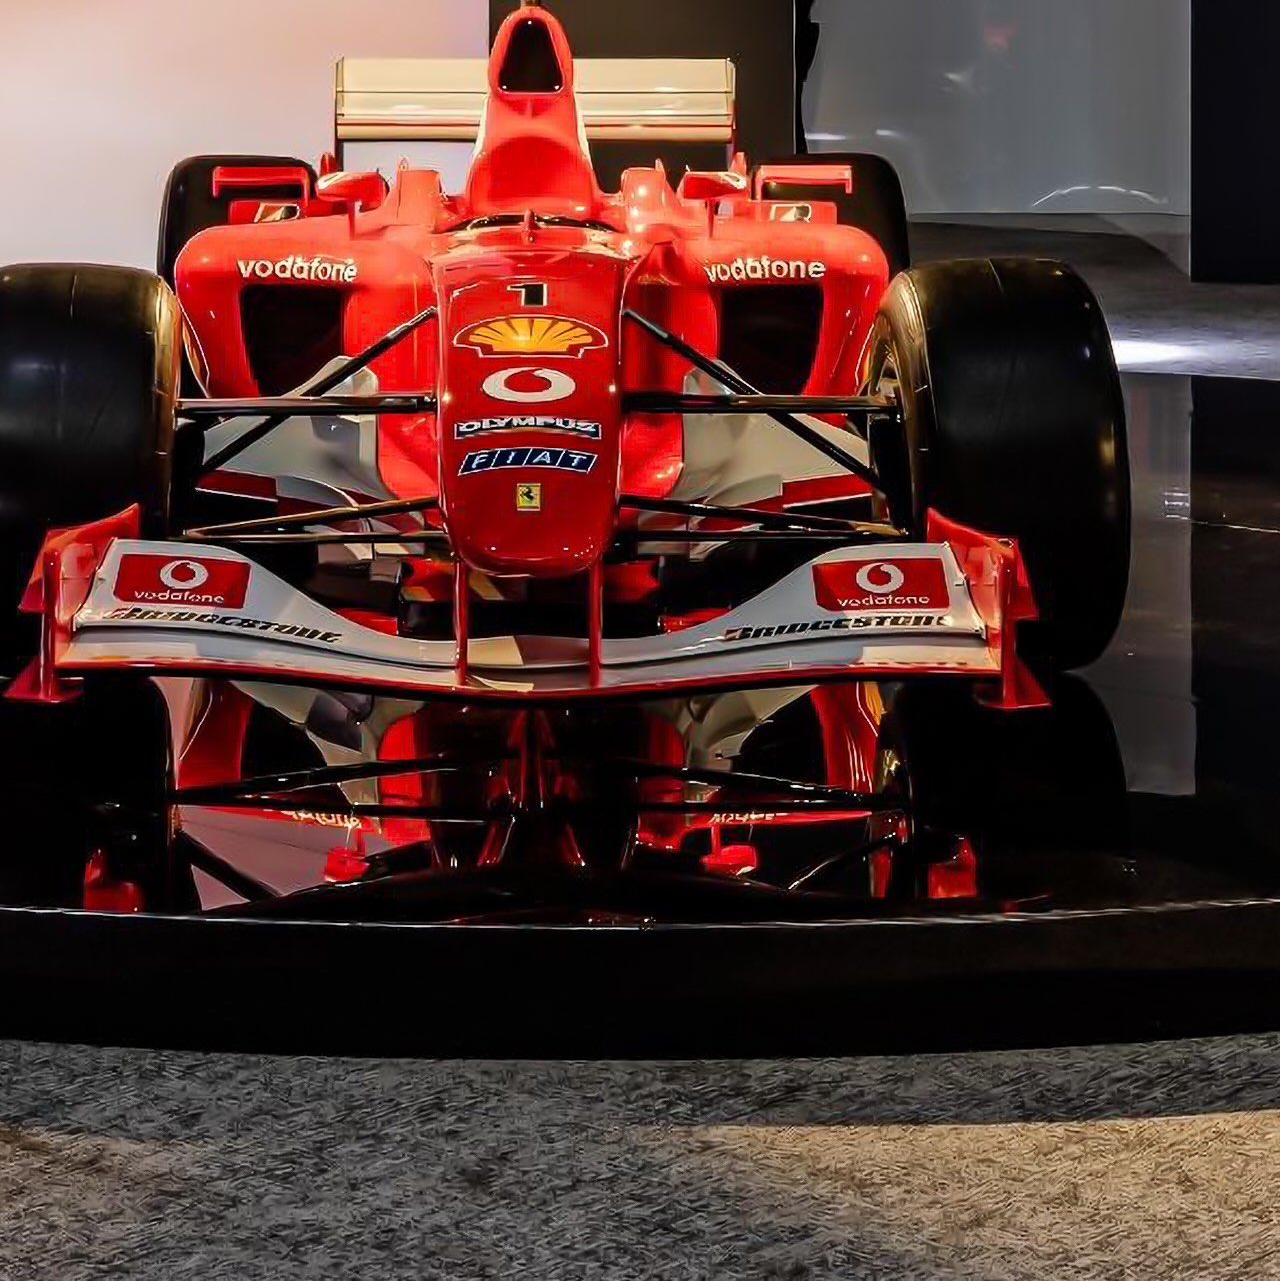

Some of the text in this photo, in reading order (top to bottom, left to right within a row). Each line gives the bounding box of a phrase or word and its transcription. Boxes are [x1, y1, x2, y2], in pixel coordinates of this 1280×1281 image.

[237, 255, 358, 282] vodafone
[704, 256, 826, 282] vodafone
[507, 282, 548, 306] 1
[458, 416, 597, 432] OLYMPUS
[471, 450, 588, 469] FIAT
[134, 589, 224, 604] vodafone
[836, 594, 930, 608] vodafone
